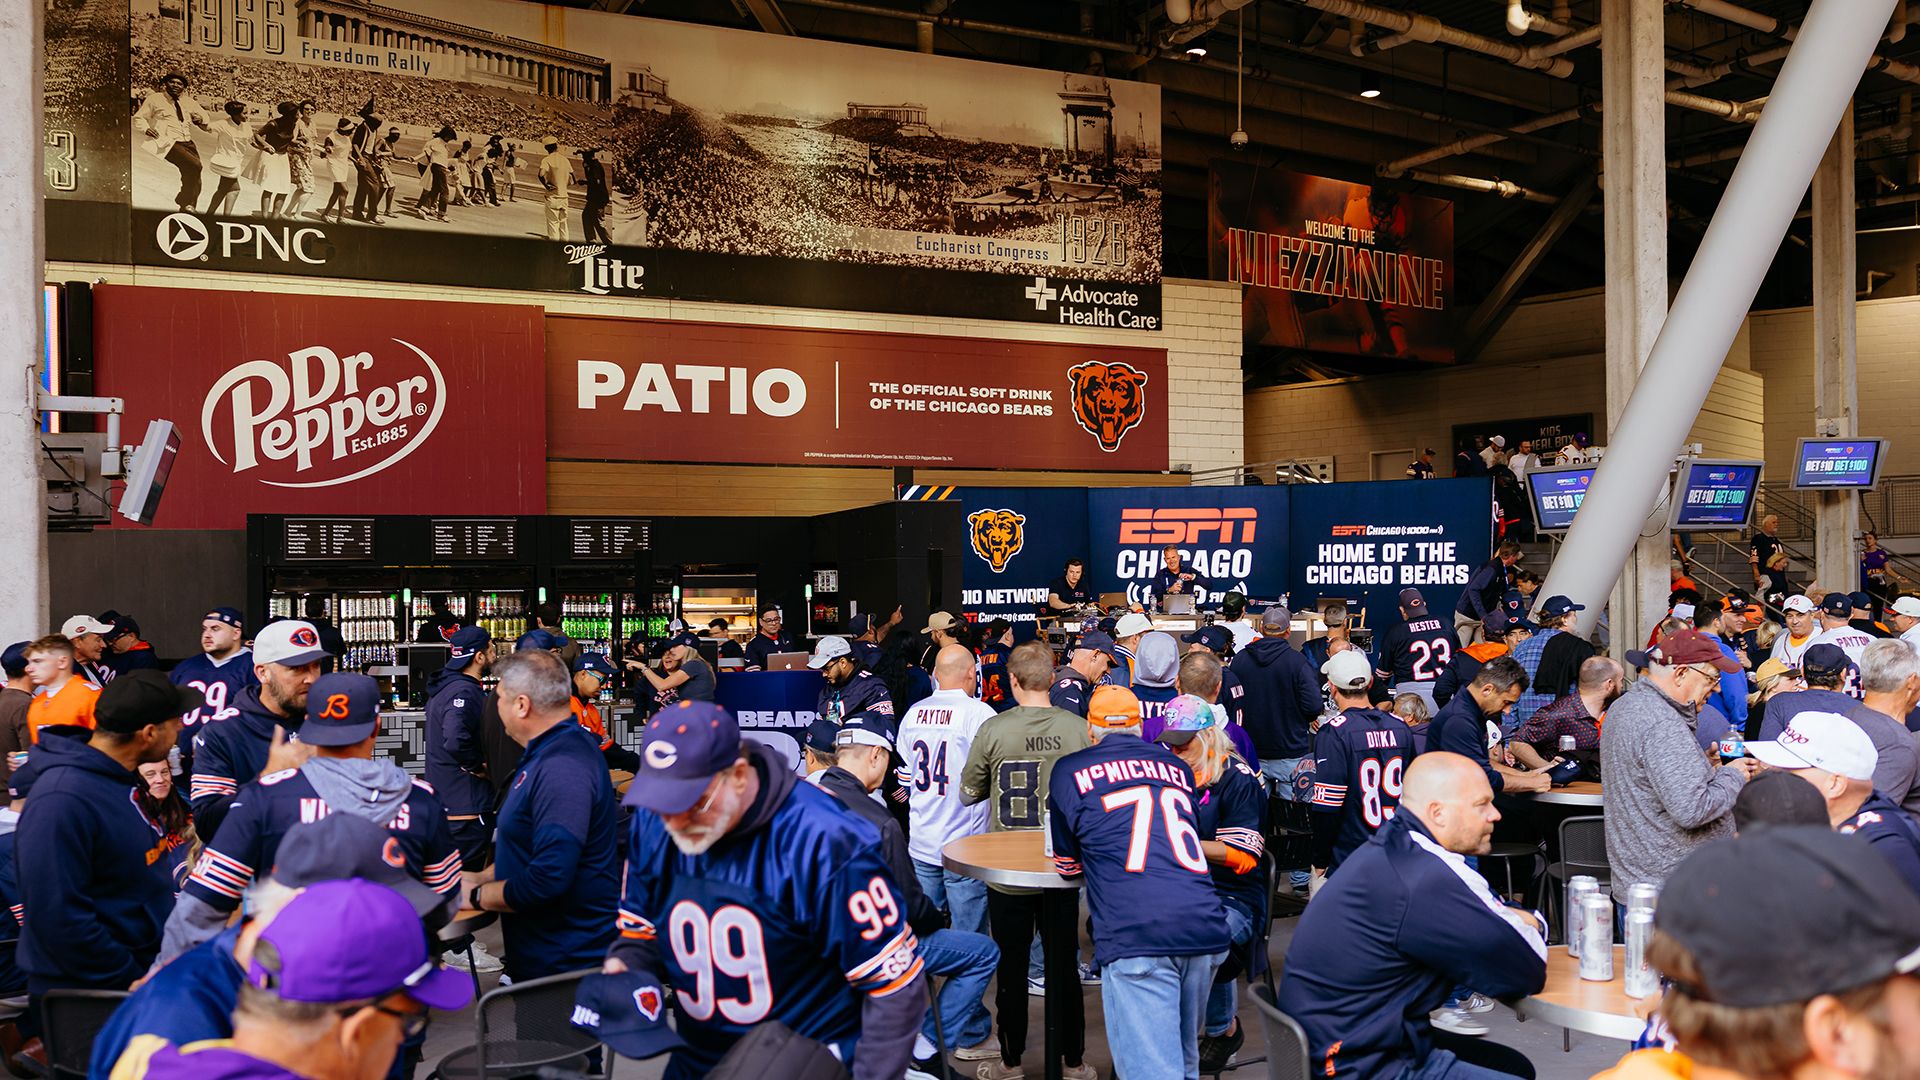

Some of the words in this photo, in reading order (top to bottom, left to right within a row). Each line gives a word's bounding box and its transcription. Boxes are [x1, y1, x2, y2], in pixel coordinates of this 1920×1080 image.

[178, 0, 285, 54] 1966
[301, 41, 381, 68] Freedom
[387, 51, 431, 76] Rally
[217, 222, 327, 265] PNC
[1056, 213, 1127, 267] 1926
[1305, 219, 1345, 241] WELCOME
[1348, 226, 1358, 242] TO
[1360, 229, 1376, 245] THE
[564, 244, 607, 264] Miller
[915, 235, 982, 255] Eucharist
[987, 241, 1050, 261] Congress
[581, 255, 644, 294] Lite
[1228, 227, 1443, 311] MEZZANINE
[1060, 284, 1139, 307] Advocate
[1059, 306, 1115, 328] Health
[1118, 310, 1157, 330] Care
[288, 345, 374, 412] Dr
[577, 359, 808, 418] PATIO
[869, 382, 900, 395] THE
[902, 384, 967, 398] OFFICIAL
[970, 386, 1005, 400] SOFT
[1009, 388, 1053, 401] DRINK
[201, 360, 428, 474] Pepper
[869, 398, 891, 410] OF
[894, 399, 926, 412] THE
[928, 400, 1001, 415] CHICAGO
[1003, 403, 1053, 417] BEARS
[1540, 425, 1561, 437] KIDS
[1530, 438, 1552, 451] EAL
[1805, 460, 1821, 472] BET
[1820, 460, 1834, 472] $10
[1834, 459, 1849, 472] GET
[1849, 459, 1868, 472] $100
[1542, 495, 1559, 510] BET
[1558, 494, 1575, 509] $10
[1687, 489, 1704, 504] BET
[1701, 489, 1716, 504] $10
[1714, 489, 1730, 504] GET
[1727, 489, 1746, 504] $100
[1119, 507, 1258, 544] ESPN
[1332, 525, 1367, 536] ESPN
[1366, 524, 1401, 536] CHICAGO
[1318, 543, 1376, 563] HOME
[1382, 542, 1410, 563] OF
[1415, 541, 1456, 562] THE
[1306, 565, 1394, 585] CHICAGO
[1400, 564, 1470, 585] BEARS
[1408, 619, 1441, 633] HESTER
[1836, 636, 1870, 648] PAYTON
[1410, 637, 1451, 681] 23
[318, 693, 350, 720] B
[916, 709, 953, 725] PAYTON
[1025, 735, 1062, 752] MOSS
[912, 739, 950, 796] 34
[1359, 755, 1403, 828] 89
[1101, 784, 1210, 875] 76
[848, 876, 900, 941] 99
[668, 899, 774, 1025] 99
